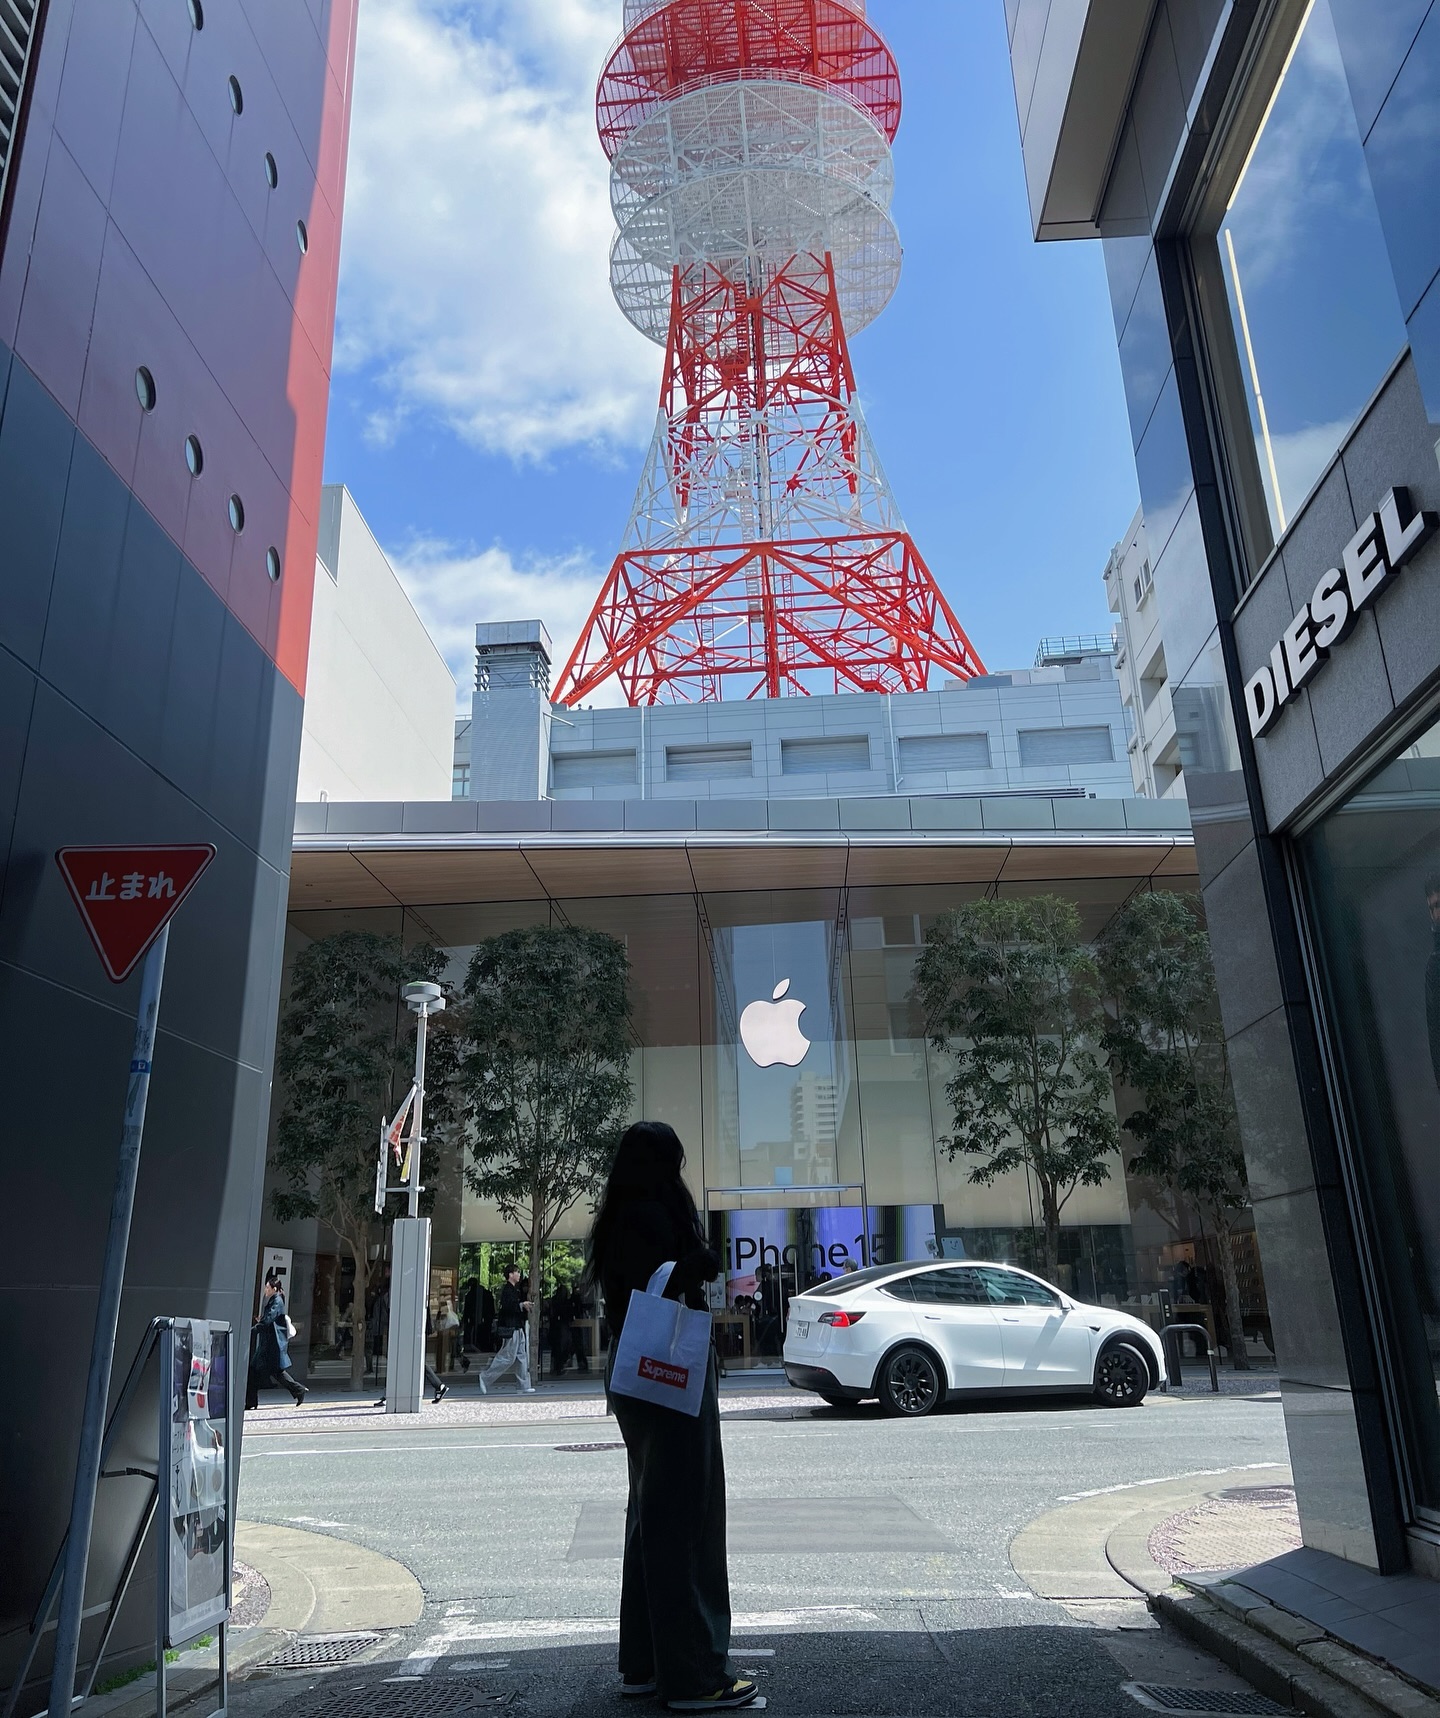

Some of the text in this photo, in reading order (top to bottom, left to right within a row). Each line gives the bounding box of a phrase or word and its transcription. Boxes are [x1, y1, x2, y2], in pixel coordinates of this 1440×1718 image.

[1244, 487, 1426, 739] DIESEL
[85, 871, 176, 900] 止まれ
[725, 1237, 850, 1270] iPhone
[642, 1359, 686, 1383] Supreme
